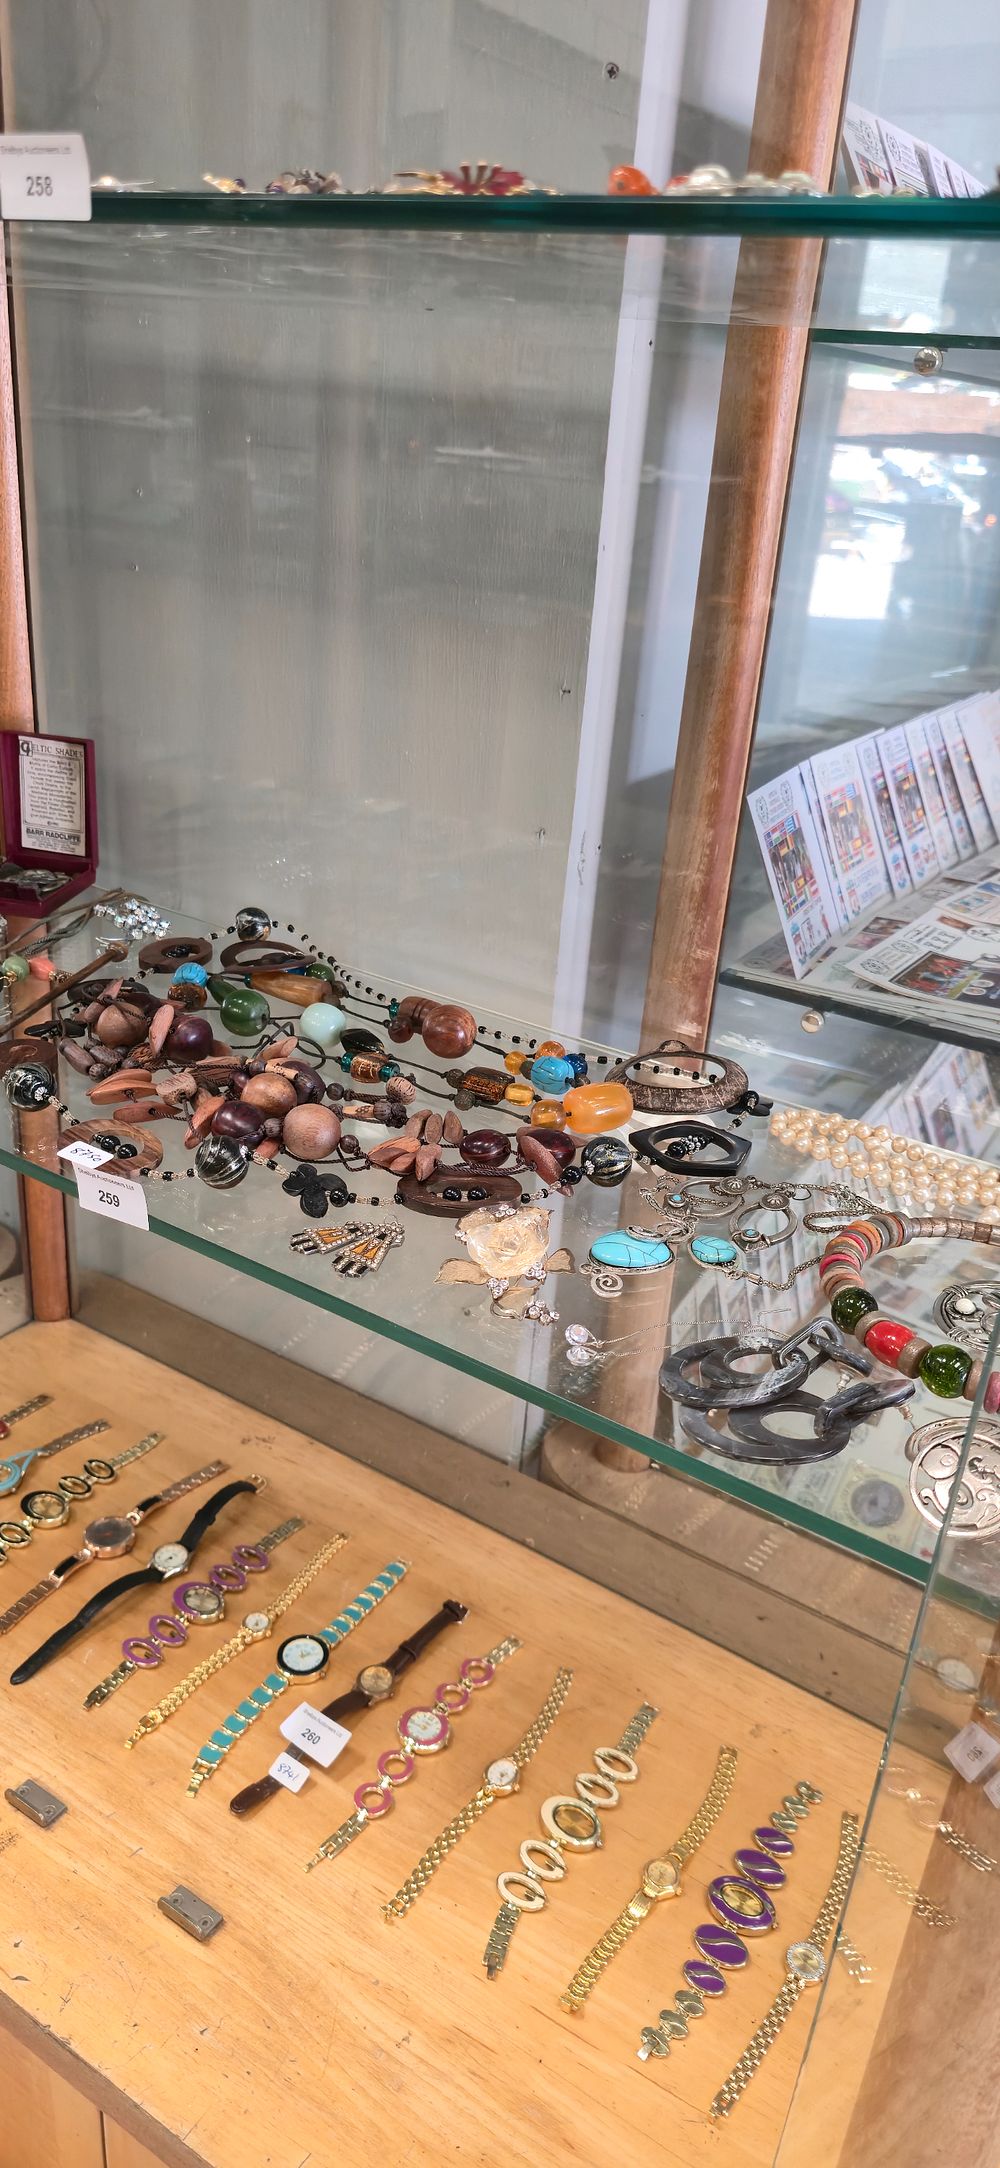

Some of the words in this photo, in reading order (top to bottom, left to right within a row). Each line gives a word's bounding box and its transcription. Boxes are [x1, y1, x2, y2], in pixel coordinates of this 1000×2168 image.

[26, 176, 53, 197] 258
[55, 747, 84, 758] SHADES
[26, 828, 45, 837] BARR
[45, 830, 81, 842] RADCLIFFE
[98, 1190, 120, 1208] 259
[301, 1728, 321, 1745] 260
